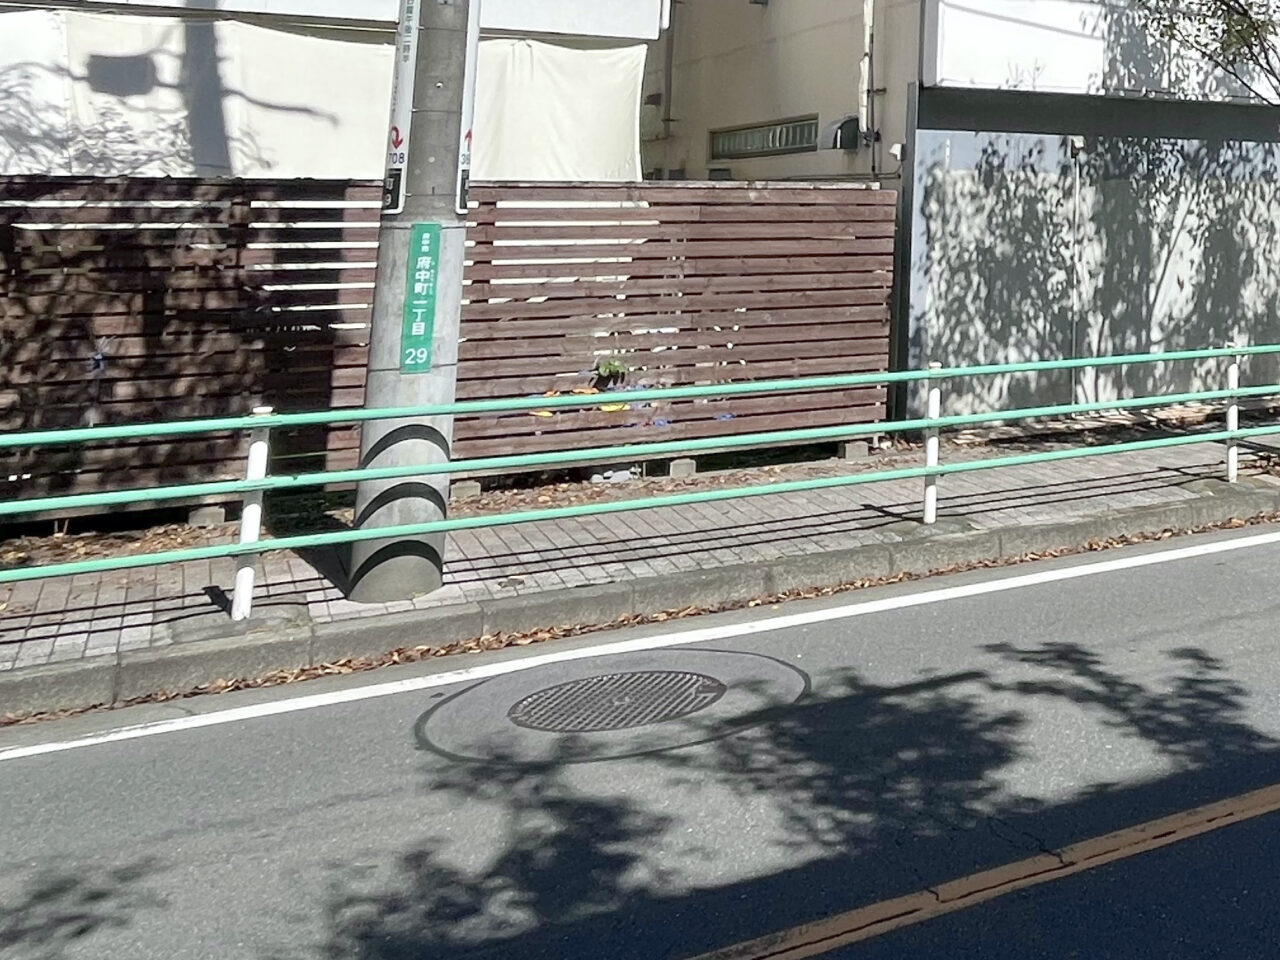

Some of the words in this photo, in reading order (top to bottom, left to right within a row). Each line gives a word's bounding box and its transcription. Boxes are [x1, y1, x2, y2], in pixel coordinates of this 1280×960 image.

[411, 256, 432, 336] 府中町一丁目
[404, 347, 428, 365] 29
